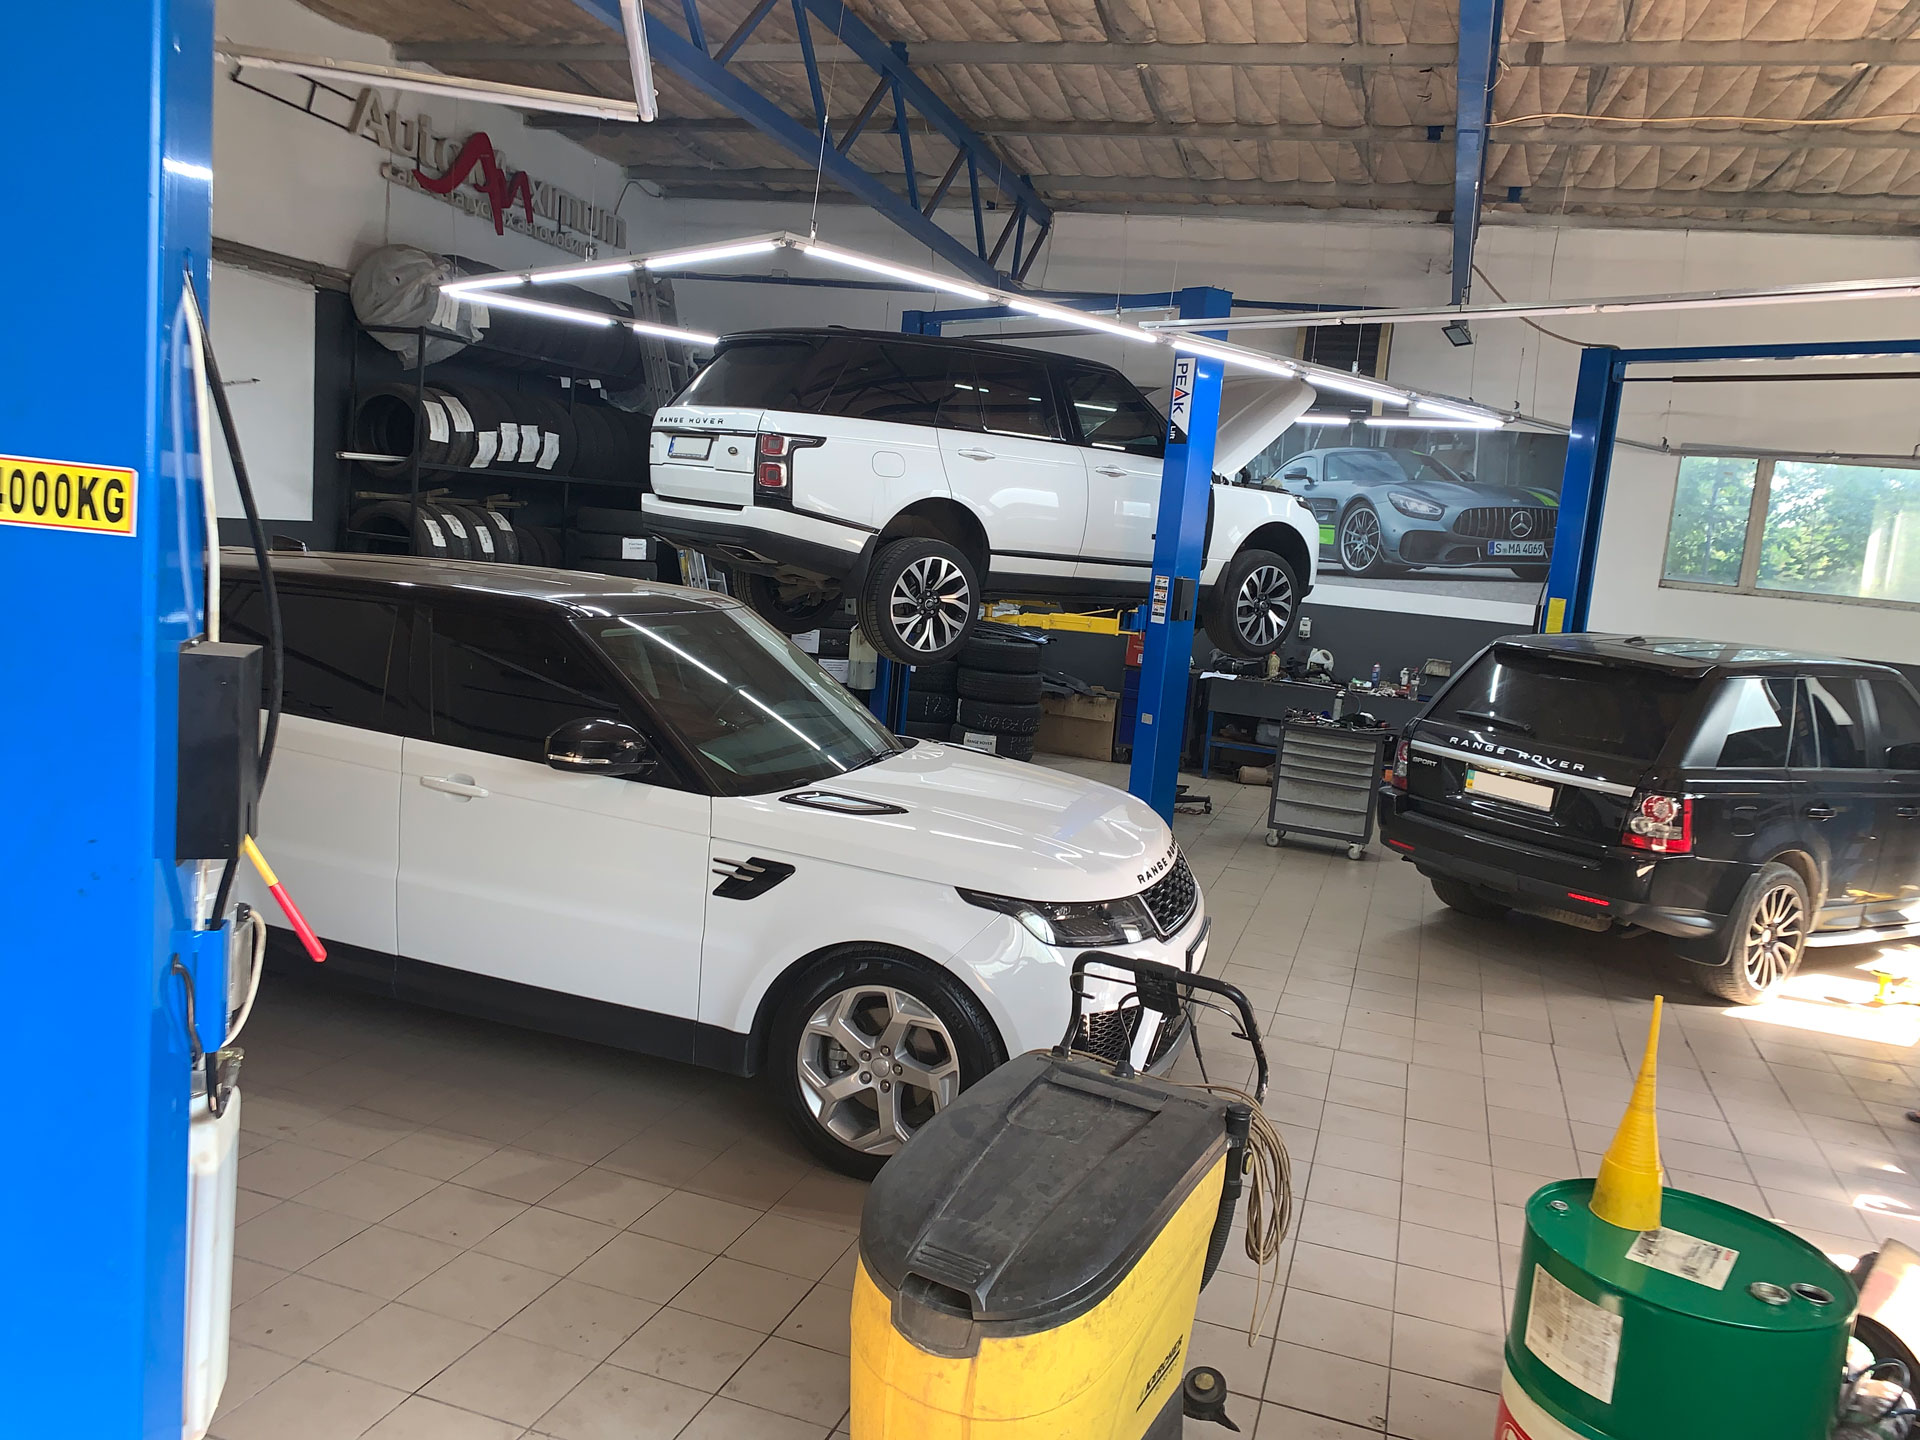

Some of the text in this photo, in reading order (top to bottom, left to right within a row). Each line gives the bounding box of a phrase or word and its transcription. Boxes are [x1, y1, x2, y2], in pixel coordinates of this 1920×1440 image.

[1172, 363, 1190, 414] PEAK
[659, 416, 684, 424] RANGE
[0, 466, 125, 523] 000KG
[1495, 543, 1502, 553] S
[1508, 543, 1521, 553] MA
[1412, 756, 1438, 768] SPORT
[1450, 736, 1586, 771] RANGE ROVER
[1136, 857, 1168, 885] RANGE
